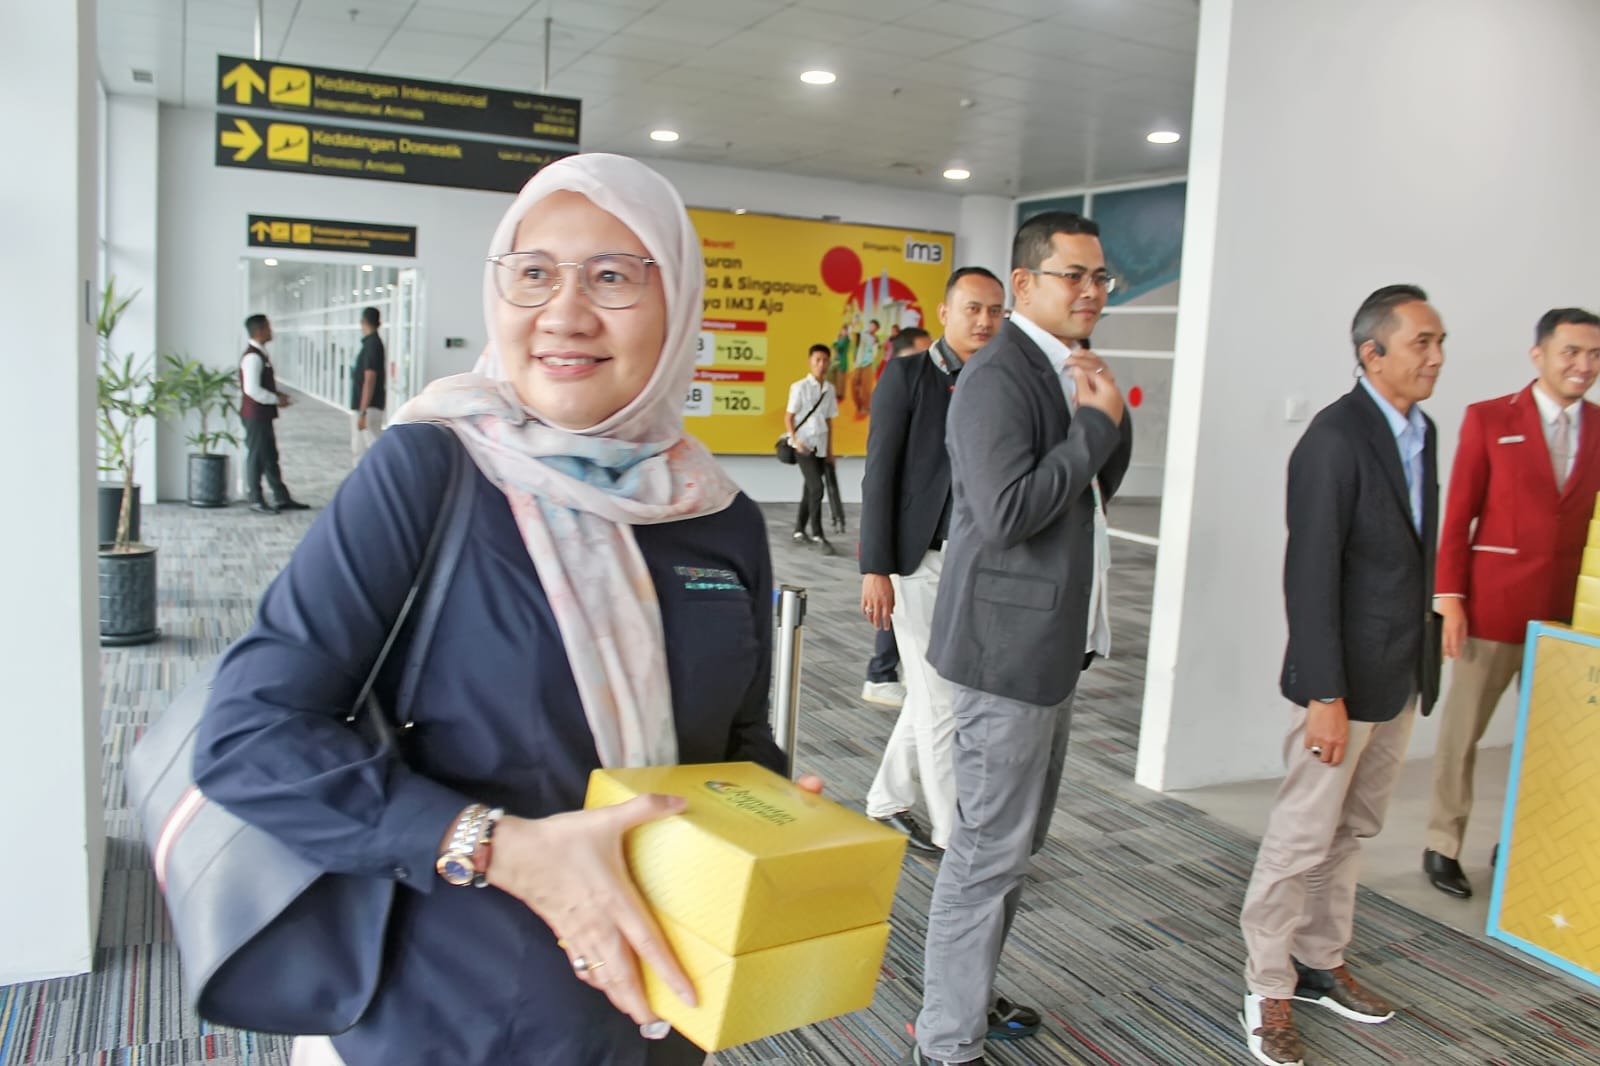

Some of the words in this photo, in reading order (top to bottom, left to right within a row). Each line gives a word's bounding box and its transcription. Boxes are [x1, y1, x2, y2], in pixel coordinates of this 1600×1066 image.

[314, 75, 398, 98] Kedatangan
[401, 84, 488, 109] Internasional
[312, 131, 397, 153] Kedatangan
[400, 139, 462, 159] Domestik
[723, 276, 733, 289] &
[738, 276, 822, 297] Singapura,
[725, 298, 754, 311] IM3
[758, 299, 784, 316] Aja
[727, 346, 753, 361] 130
[724, 396, 750, 411] 120
